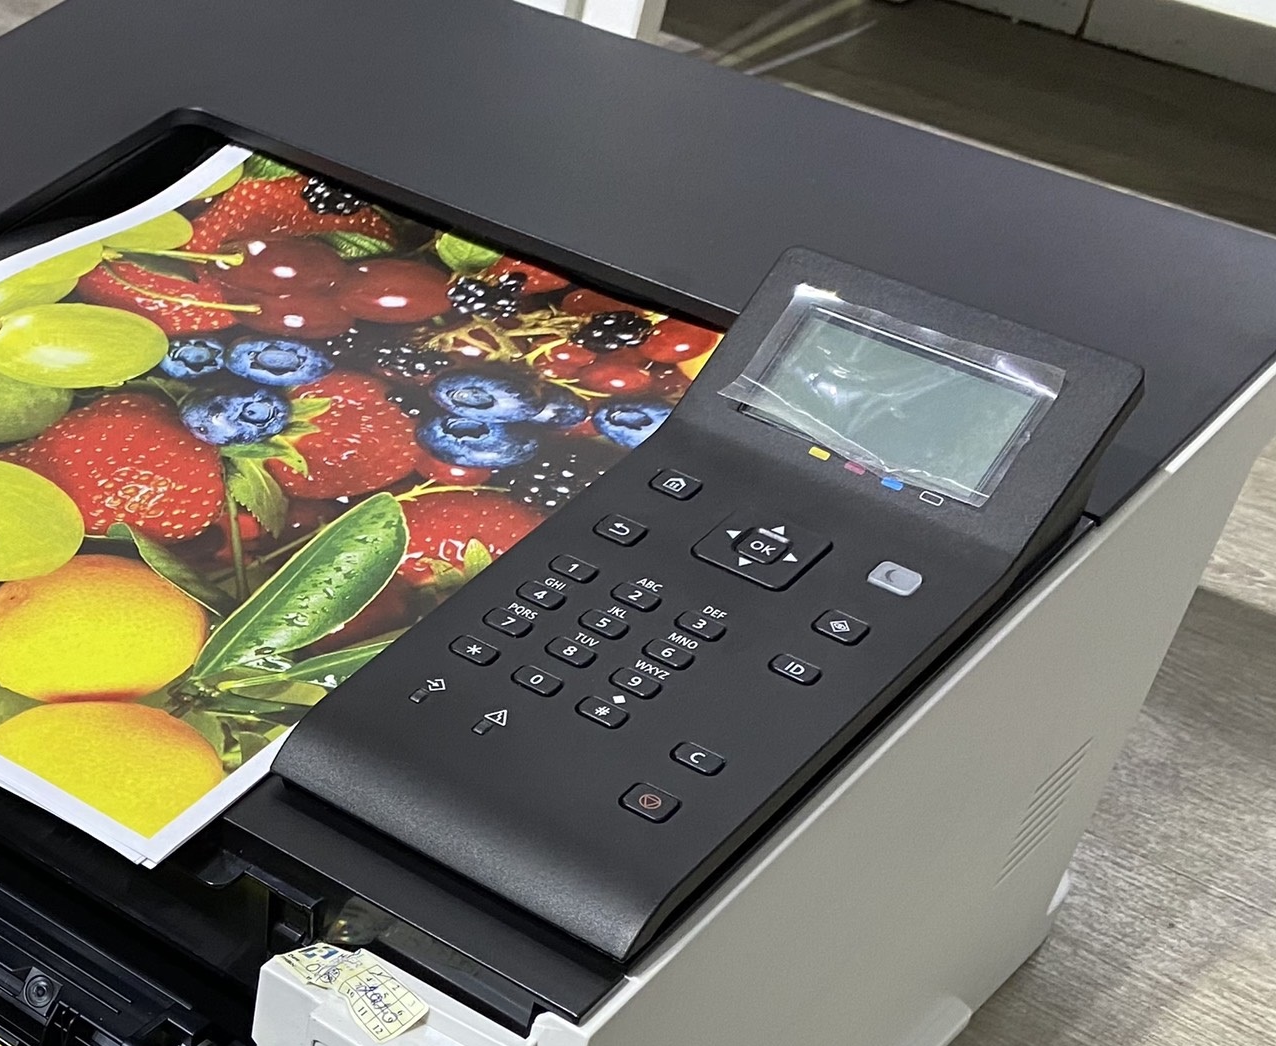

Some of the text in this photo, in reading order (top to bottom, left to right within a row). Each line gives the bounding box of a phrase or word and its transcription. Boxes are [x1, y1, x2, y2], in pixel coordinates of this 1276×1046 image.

[750, 540, 777, 556] OK
[568, 563, 579, 573] 1
[544, 577, 567, 591] GHI
[636, 577, 664, 592] ABC
[534, 590, 548, 600] 4
[628, 590, 643, 601] 2
[508, 602, 538, 621] PQRS
[607, 606, 627, 619] JKL
[702, 605, 728, 620] DEF
[501, 617, 516, 627] 7
[596, 617, 612, 628] 5
[692, 619, 707, 629] 3
[575, 632, 600, 648] TUV
[668, 632, 699, 650] MNO
[563, 646, 578, 657] 8
[661, 647, 676, 658] 6
[635, 659, 670, 681] WXYZ
[784, 661, 805, 676] ID
[530, 674, 544, 685] 0
[627, 676, 643, 687] 9
[690, 752, 706, 764] C
[372, 1024, 384, 1034] 12
